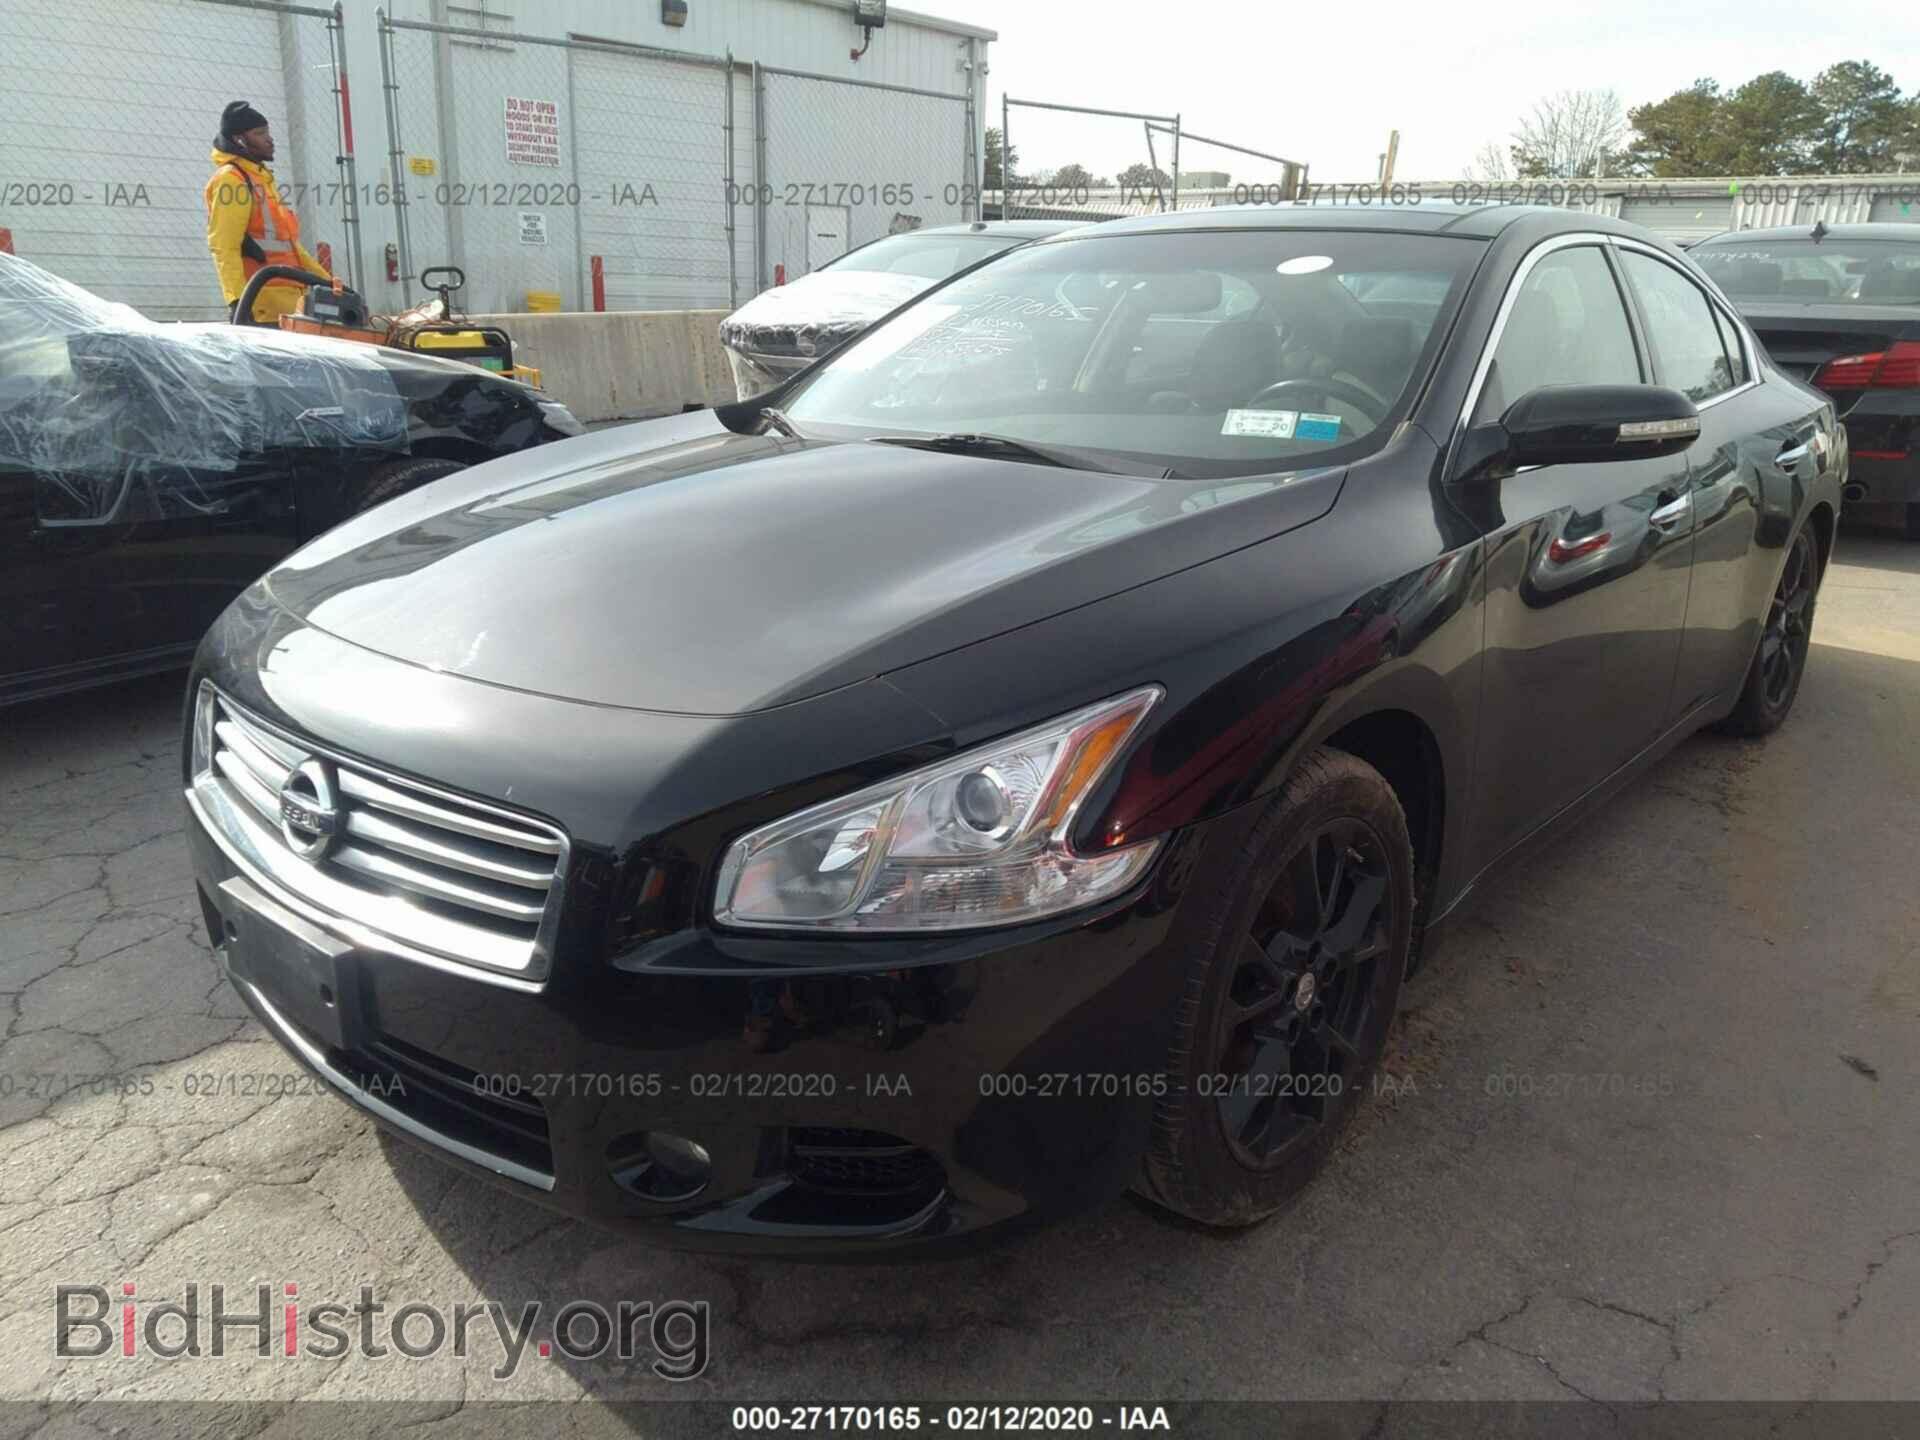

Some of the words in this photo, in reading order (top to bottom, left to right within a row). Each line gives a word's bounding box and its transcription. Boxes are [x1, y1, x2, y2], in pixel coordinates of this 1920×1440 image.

[507, 98, 517, 110] DO
[520, 100, 534, 112] NOT
[536, 102, 555, 114] OPEN
[507, 132, 542, 144] WITHOUT
